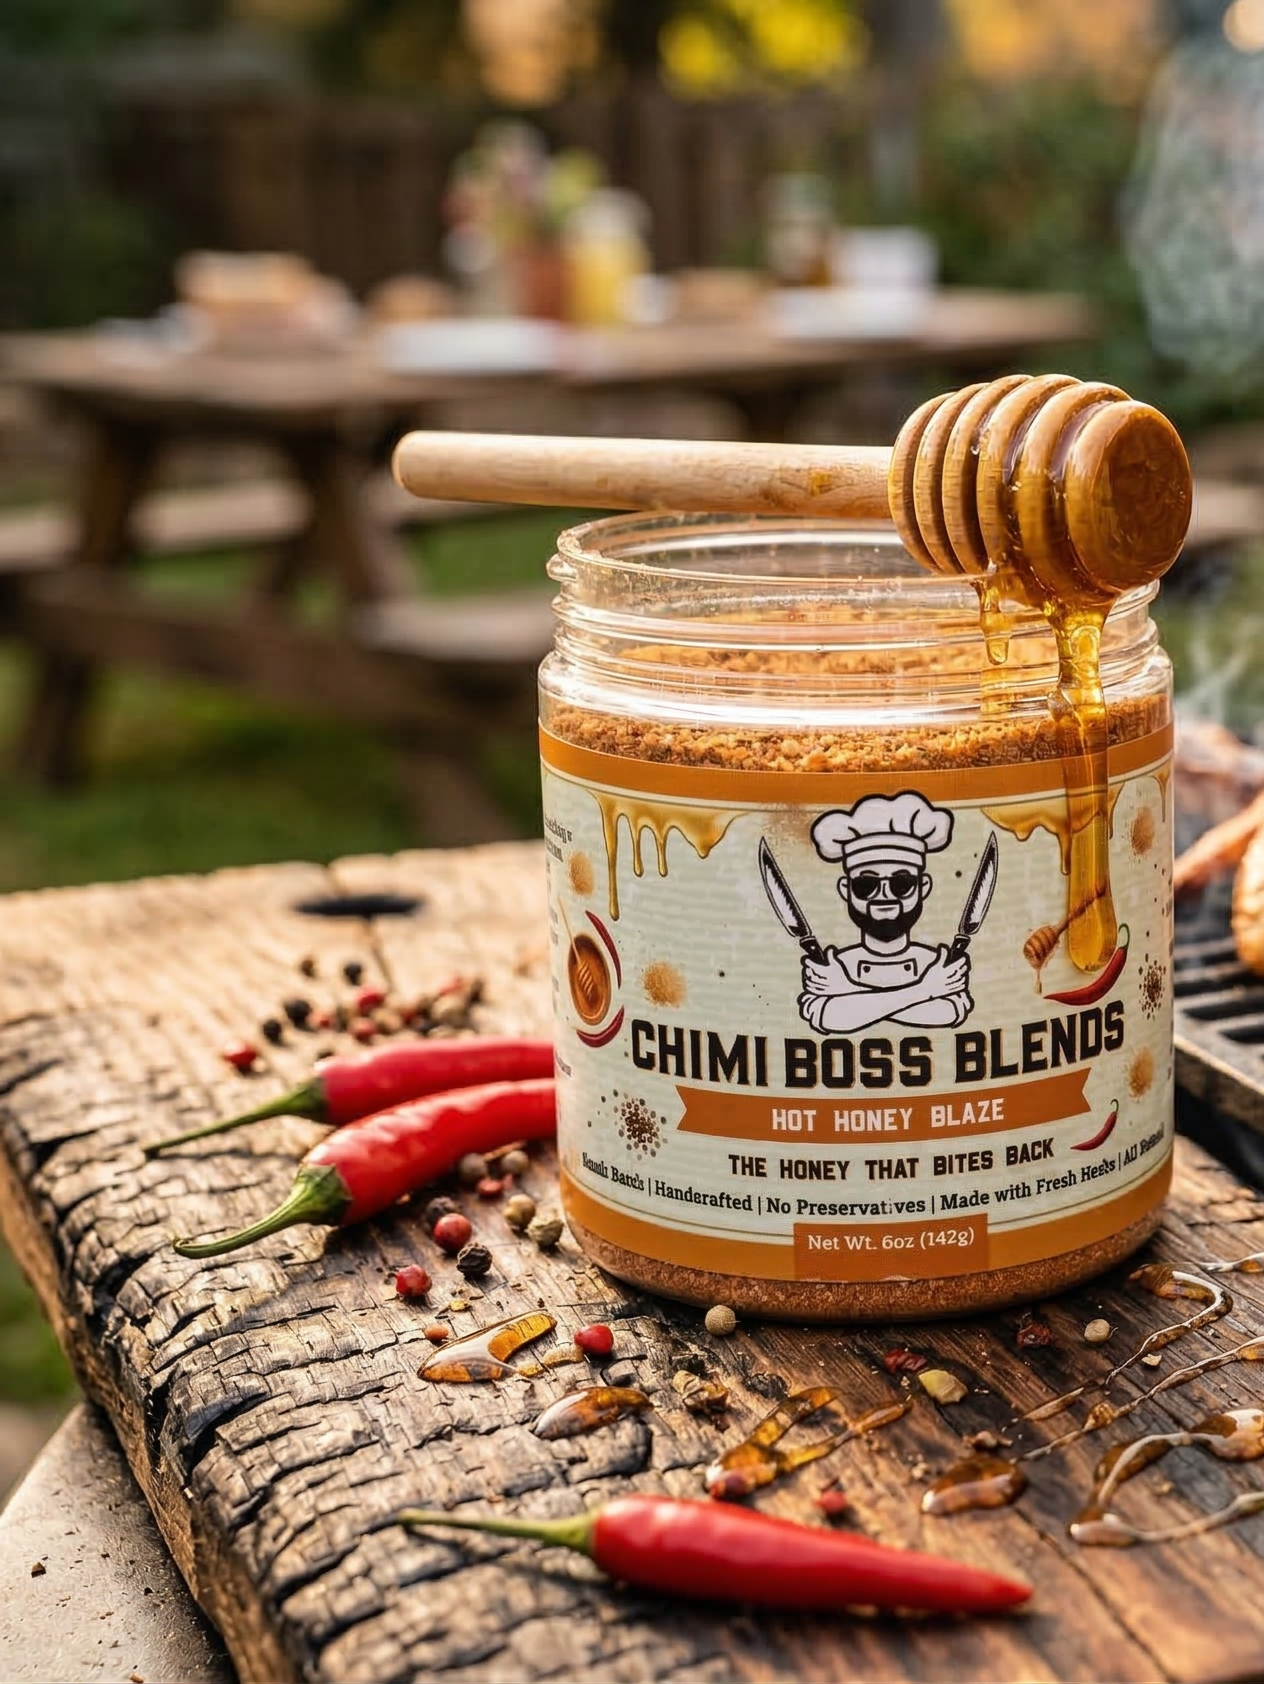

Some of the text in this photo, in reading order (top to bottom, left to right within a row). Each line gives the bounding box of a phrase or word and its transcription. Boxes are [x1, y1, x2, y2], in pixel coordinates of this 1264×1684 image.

[632, 1019, 768, 1087] CHIMI
[785, 1036, 933, 1088] BOSS
[955, 1000, 1125, 1083] BLENDS
[772, 1098, 1005, 1132] HOT HONEY BLAZE
[728, 1137, 1054, 1180] THE HONEY THAT BITES BACK
[766, 1197, 791, 1214] No
[940, 1190, 989, 1210] Made
[994, 1182, 1031, 1203] with
[1036, 1169, 1077, 1194] Fresh
[808, 1226, 975, 1250] Net Wt. 6oz (142g)
